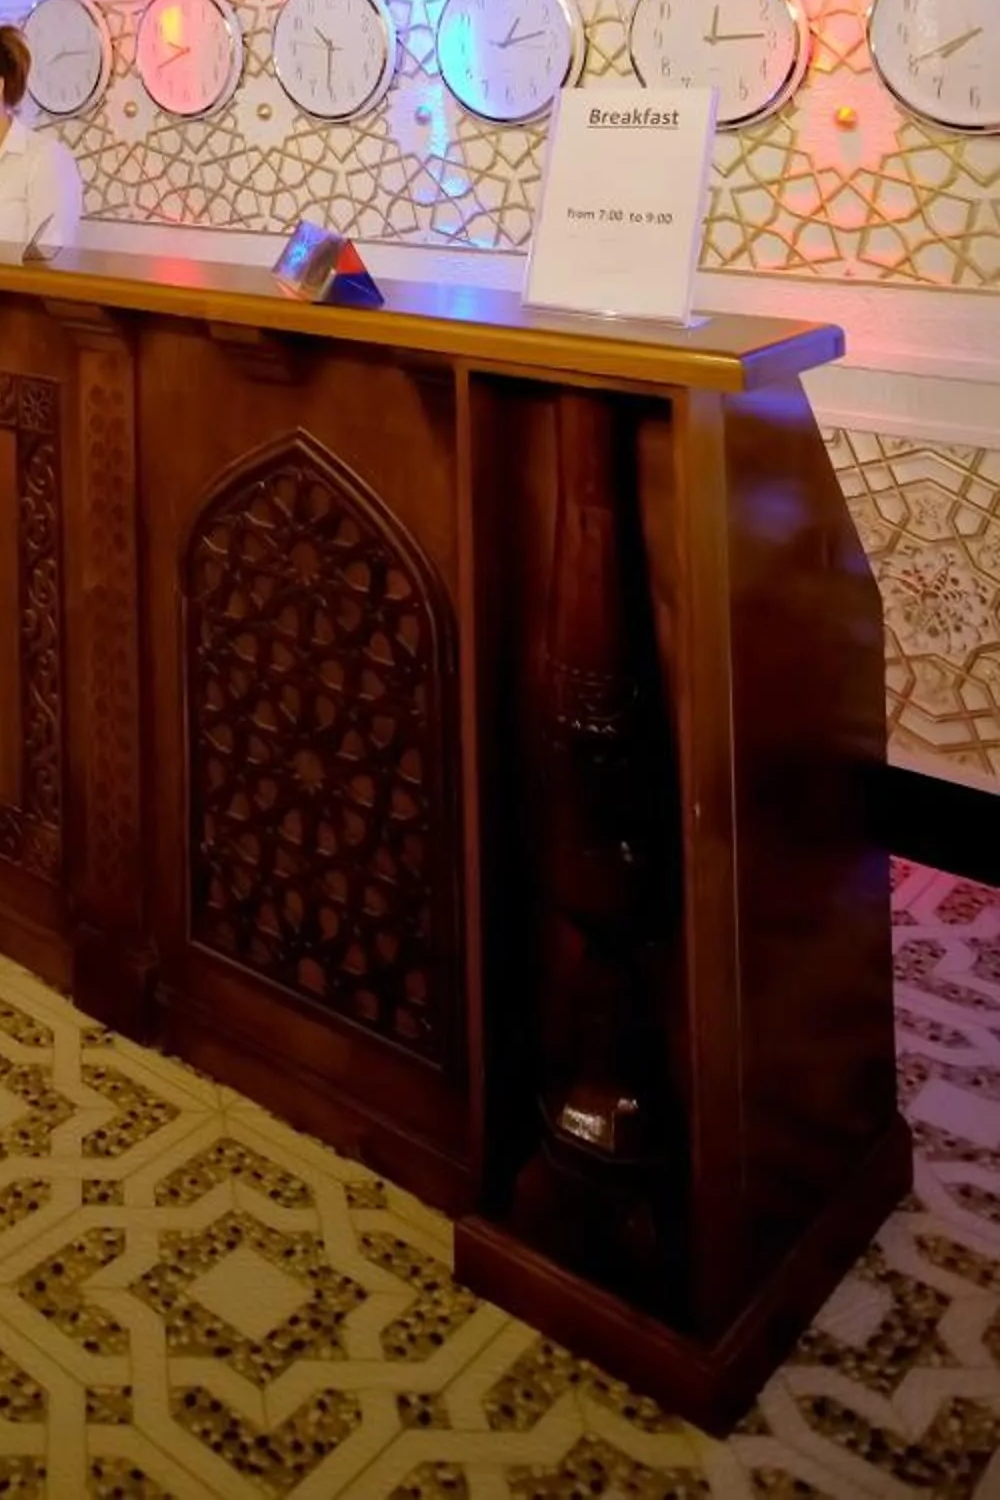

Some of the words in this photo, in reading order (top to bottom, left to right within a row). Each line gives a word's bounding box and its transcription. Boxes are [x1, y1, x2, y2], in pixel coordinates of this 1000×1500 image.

[588, 108, 681, 126] Breakfast
[567, 207, 596, 221] from
[599, 208, 624, 222] 7:00
[629, 210, 643, 224] to
[646, 211, 674, 225] 9:00
